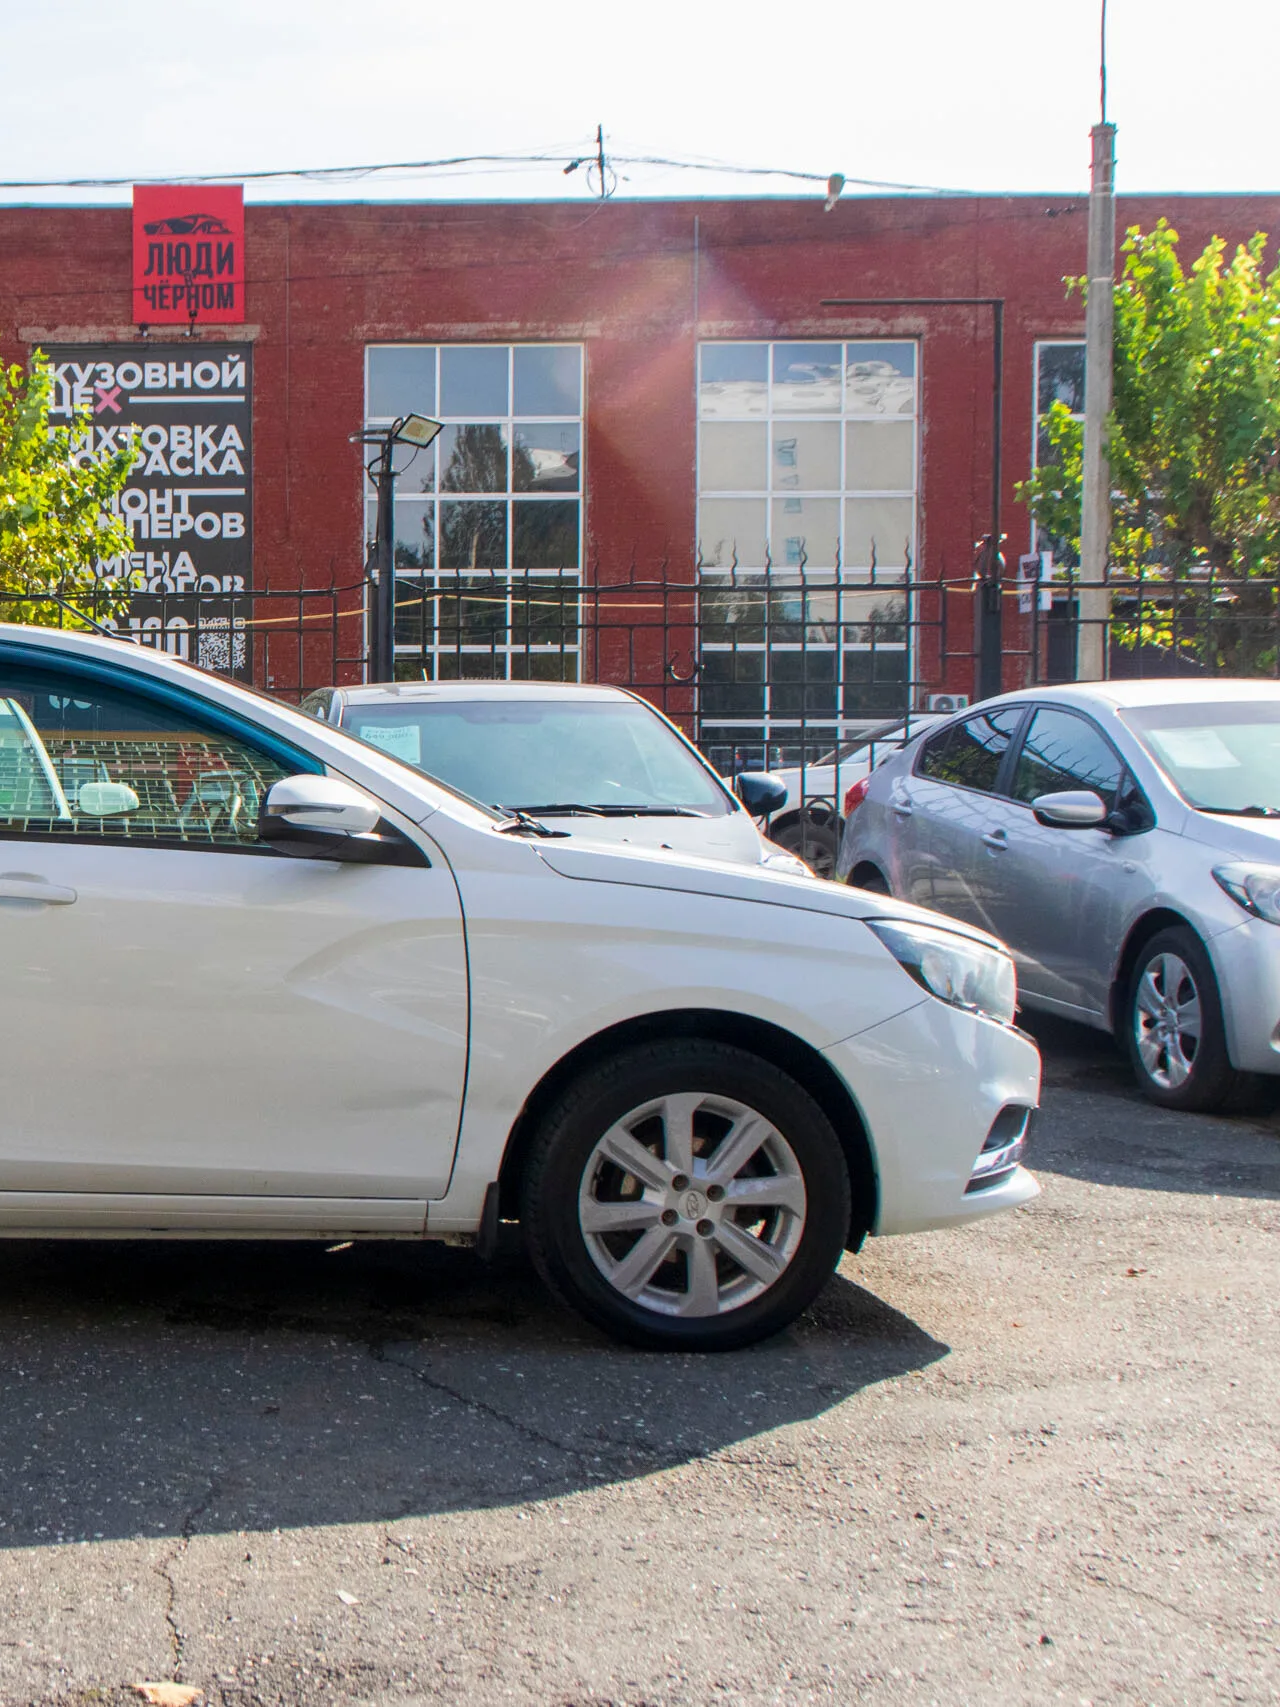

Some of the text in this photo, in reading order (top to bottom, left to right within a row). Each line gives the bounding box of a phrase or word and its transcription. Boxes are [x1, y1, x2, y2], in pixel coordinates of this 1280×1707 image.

[144, 242, 234, 278] ЛЮДИ
[144, 280, 234, 309] ЧЁРНОМ
[50, 354, 245, 389] КУЗОВНОЙ
[48, 386, 122, 418] ЦЕХ
